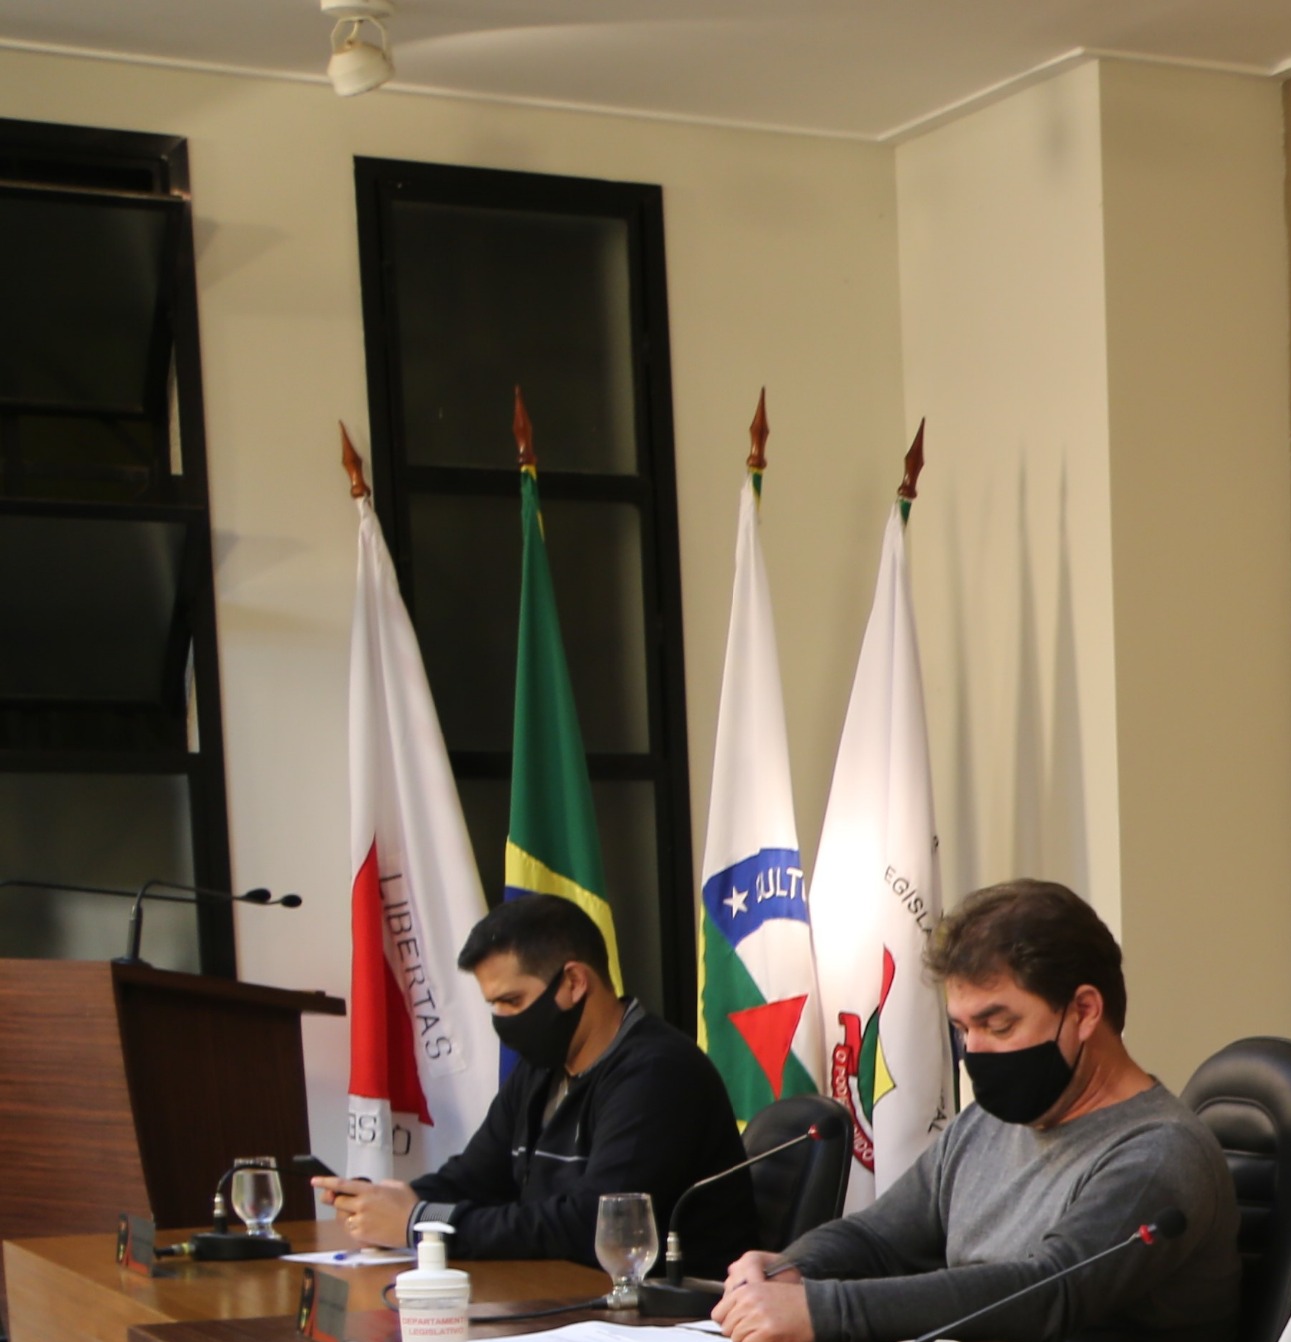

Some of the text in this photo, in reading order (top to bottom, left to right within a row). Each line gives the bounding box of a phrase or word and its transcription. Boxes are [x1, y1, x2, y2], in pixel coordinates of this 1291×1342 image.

[379, 872, 452, 1060] LIBERTAS
[402, 1316, 466, 1326] DEPARTAMENT
[408, 1326, 465, 1336] LEGISLATIVO
